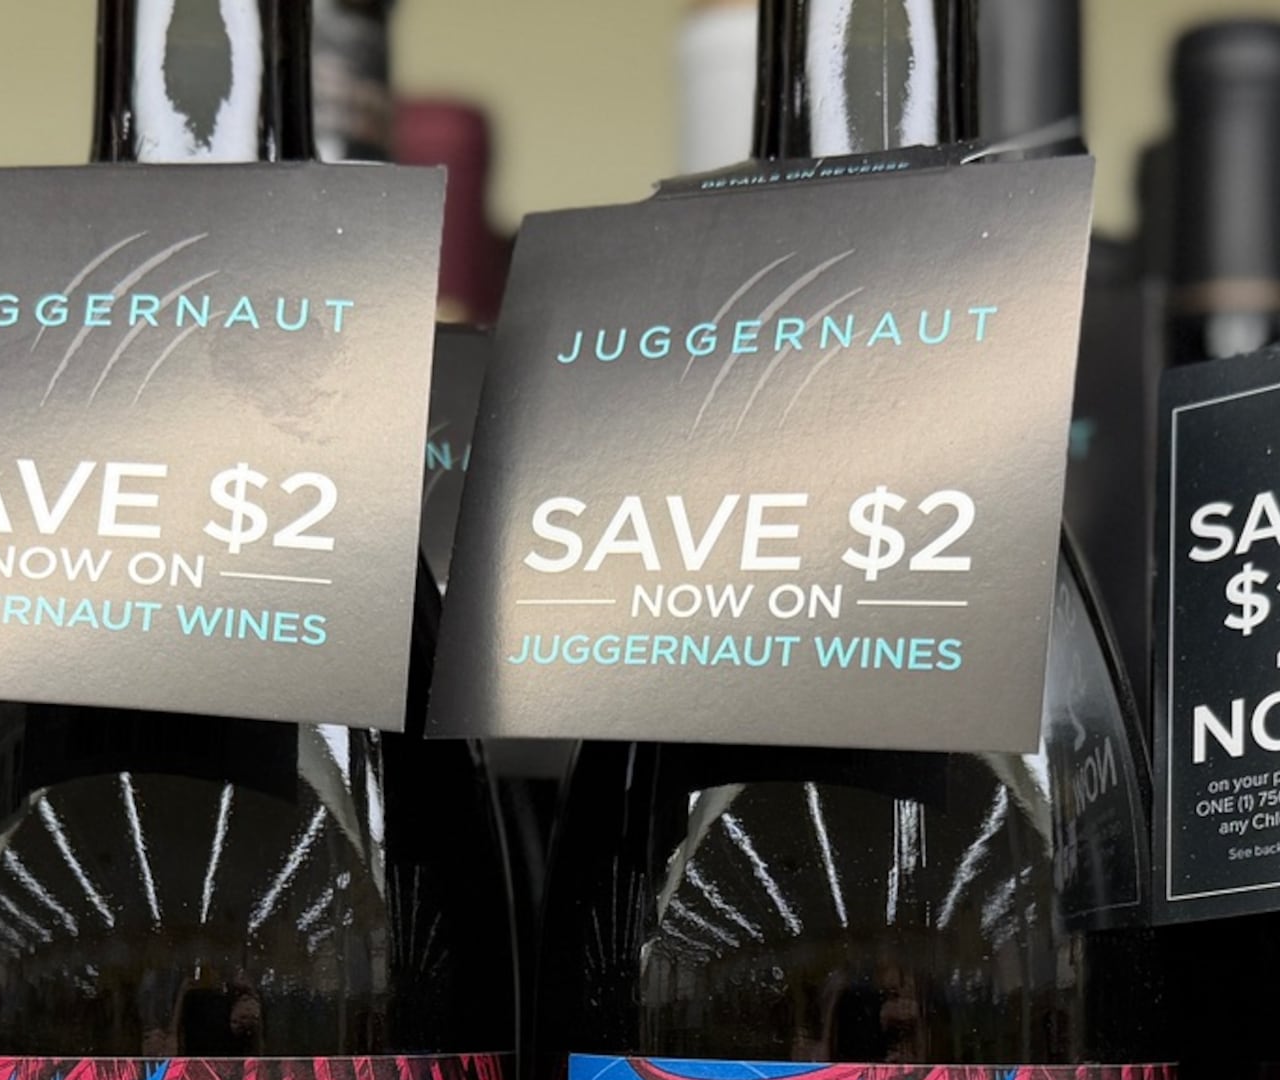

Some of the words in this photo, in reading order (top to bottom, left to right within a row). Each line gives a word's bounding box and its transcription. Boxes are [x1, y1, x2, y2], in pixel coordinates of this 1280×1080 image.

[557, 306, 999, 364] JUGGERNAUT
[203, 461, 340, 555] $2
[523, 493, 809, 573] SAVE
[841, 485, 977, 582] $2
[128, 552, 206, 588] ON
[630, 584, 754, 618] NOW
[768, 585, 843, 619] ON
[176, 603, 328, 646] WINES
[508, 634, 800, 668] JUGGERNAUT
[814, 636, 963, 671] WINES
[1208, 780, 1230, 794] on
[1232, 773, 1268, 794] your
[1196, 796, 1234, 817] ONE
[1219, 818, 1249, 836] any
[1228, 846, 1253, 860] See
